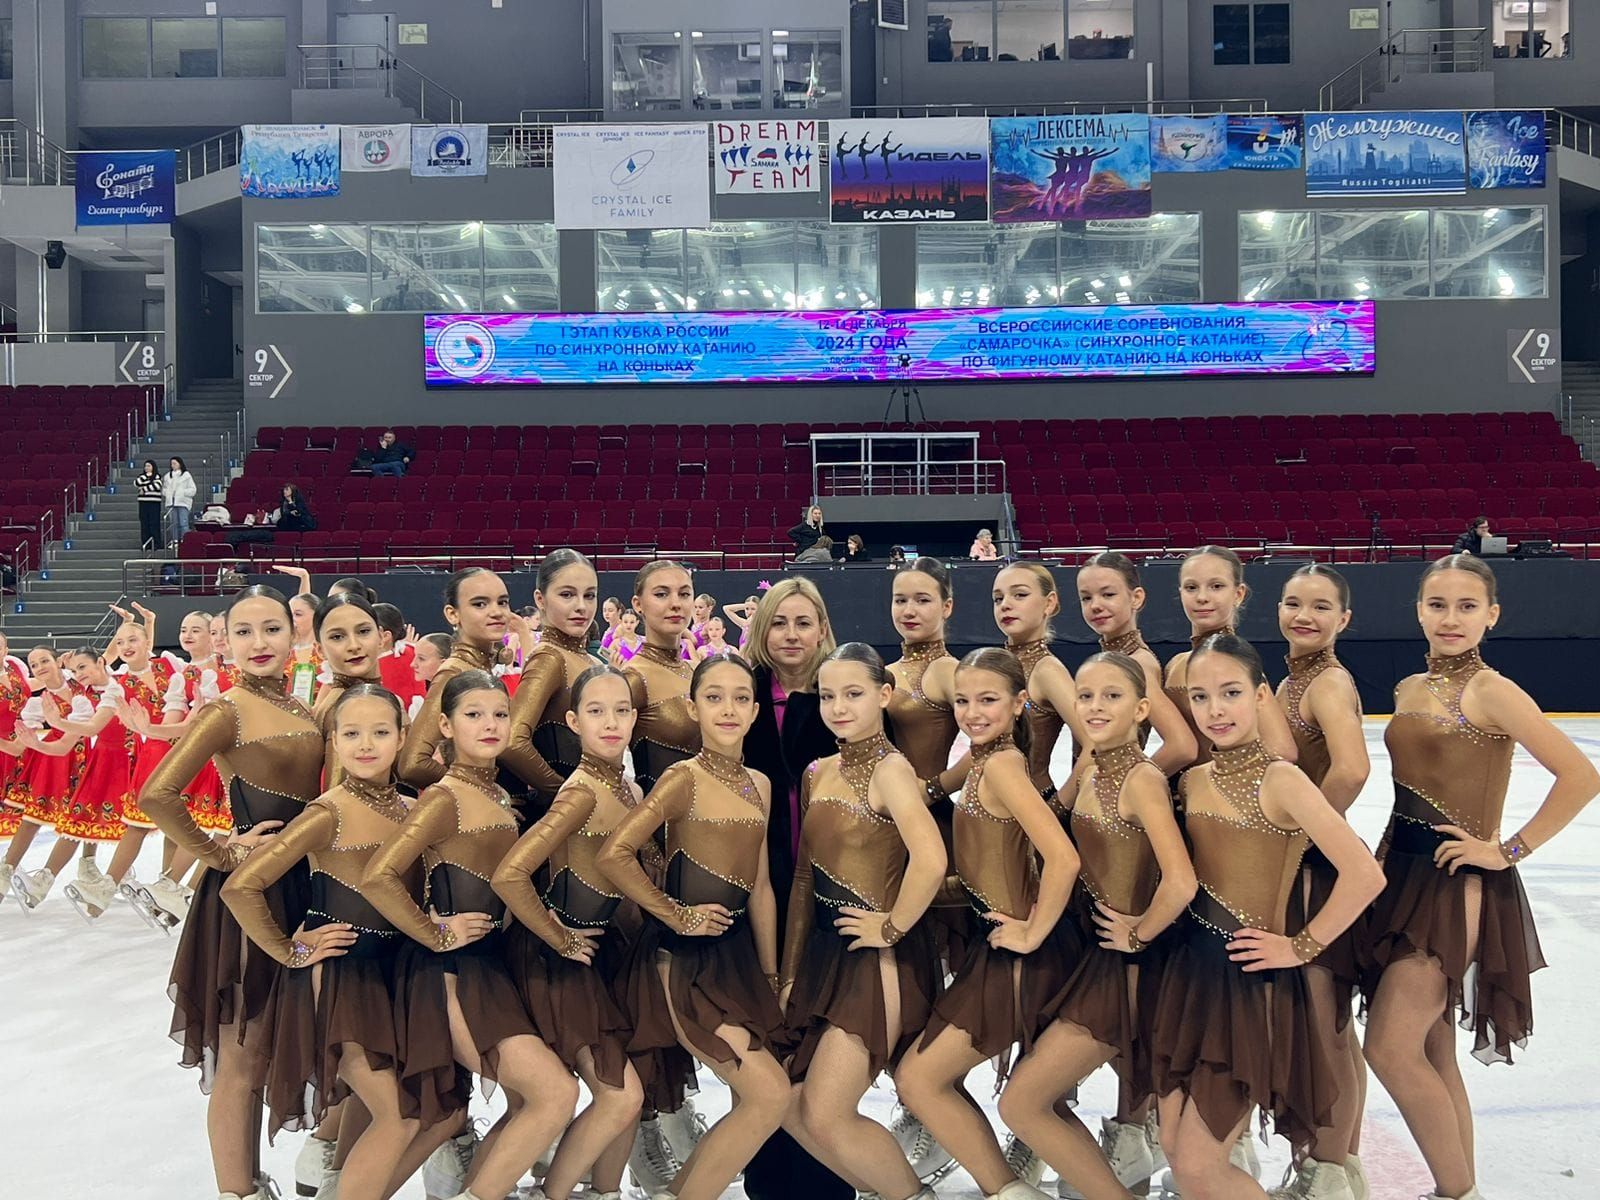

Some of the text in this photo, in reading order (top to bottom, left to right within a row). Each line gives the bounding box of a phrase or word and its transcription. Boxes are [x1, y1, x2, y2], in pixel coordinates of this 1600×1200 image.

[358, 129, 394, 139] АВРОРА
[717, 121, 815, 145] DREAM
[1036, 119, 1105, 140] ЛЕКСЕМА
[1309, 117, 1460, 151] Жемчужина
[1507, 116, 1539, 142] Ice
[898, 151, 982, 162] ИДЕЛЬ
[1480, 144, 1540, 176] Fantasy
[727, 164, 810, 189] TEAM
[1381, 178, 1431, 187] Togliatti
[592, 194, 673, 206] CRYSTAL ICE
[87, 203, 164, 218] Екатеринбург
[610, 208, 655, 218] FAMILY
[863, 209, 956, 220] КАЗАНЬ
[1117, 316, 1246, 331] СОРЕВНОВАНИЯ
[570, 326, 609, 338] ЭТАП
[614, 326, 662, 338] КУБКА
[666, 325, 729, 338] РОССИИ
[535, 342, 756, 356] ПО СИНХРОННОМУ КАТАНИЮ
[815, 335, 908, 351] 2024 ГОДА
[1075, 335, 1186, 350] (СИНХРОННОЕ
[1537, 333, 1550, 357] 9
[142, 345, 155, 368] 8
[255, 349, 268, 373] 9
[962, 350, 1264, 368] ПО ФИГУРНОМУ КАТАНИЮ НА КОНЬКАХ
[1531, 358, 1556, 366] СЕКТОР
[598, 360, 695, 372] НА КОНЬКАХ
[249, 374, 273, 382] СЕКТОР
